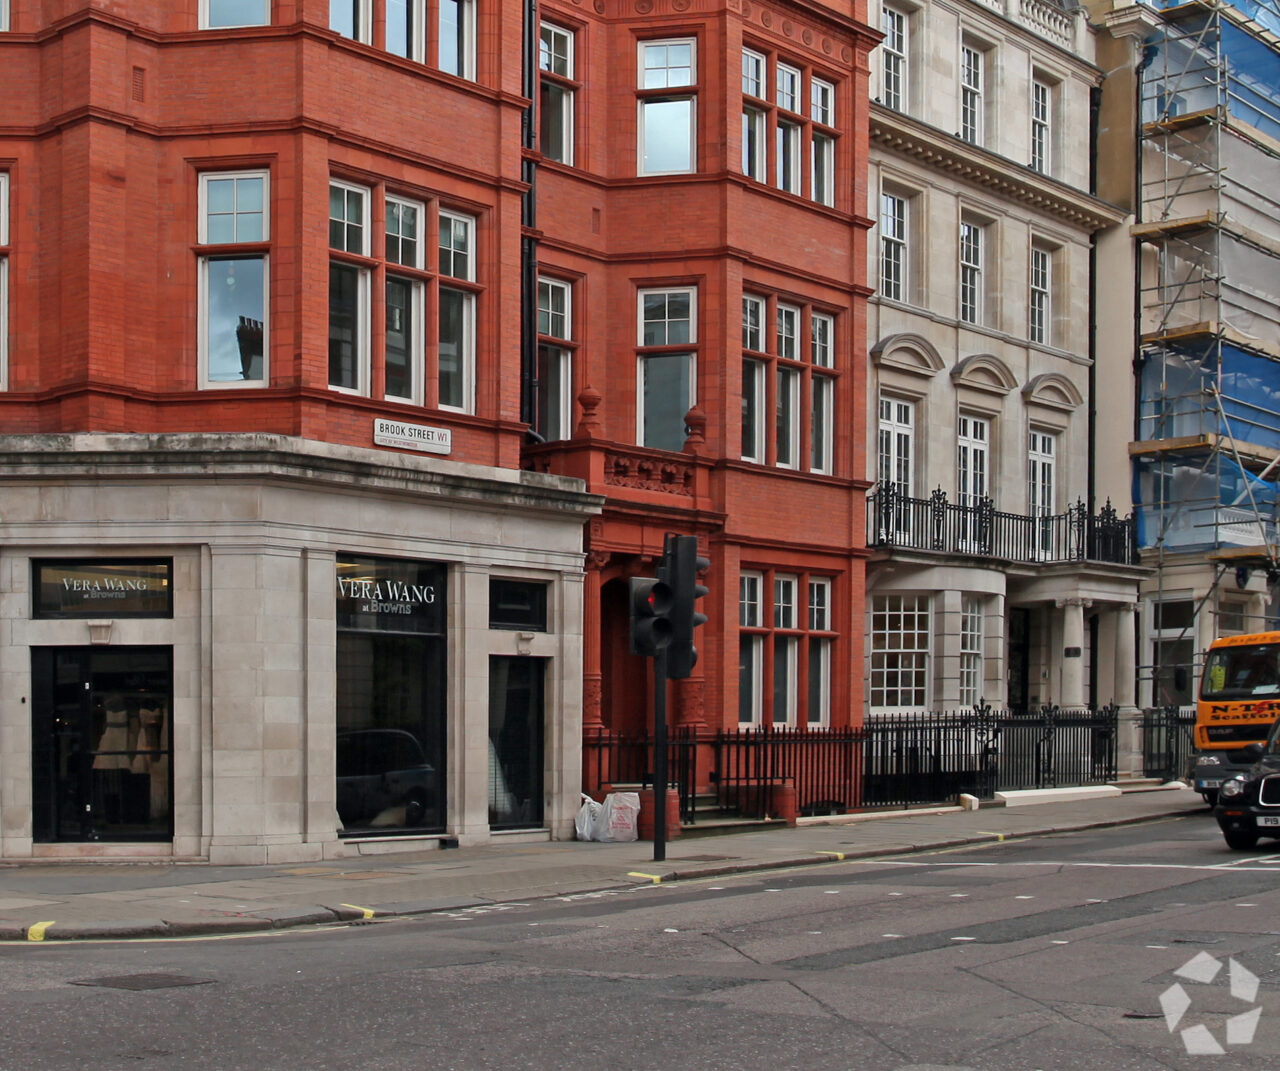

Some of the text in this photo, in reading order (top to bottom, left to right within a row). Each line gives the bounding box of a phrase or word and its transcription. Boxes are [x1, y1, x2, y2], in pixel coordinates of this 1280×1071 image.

[379, 423, 448, 442] BROOK STREET W1
[62, 577, 147, 591] VERA WANG
[337, 576, 435, 604] VERA WANG
[91, 590, 126, 599] Browns
[362, 600, 412, 615] at Browns
